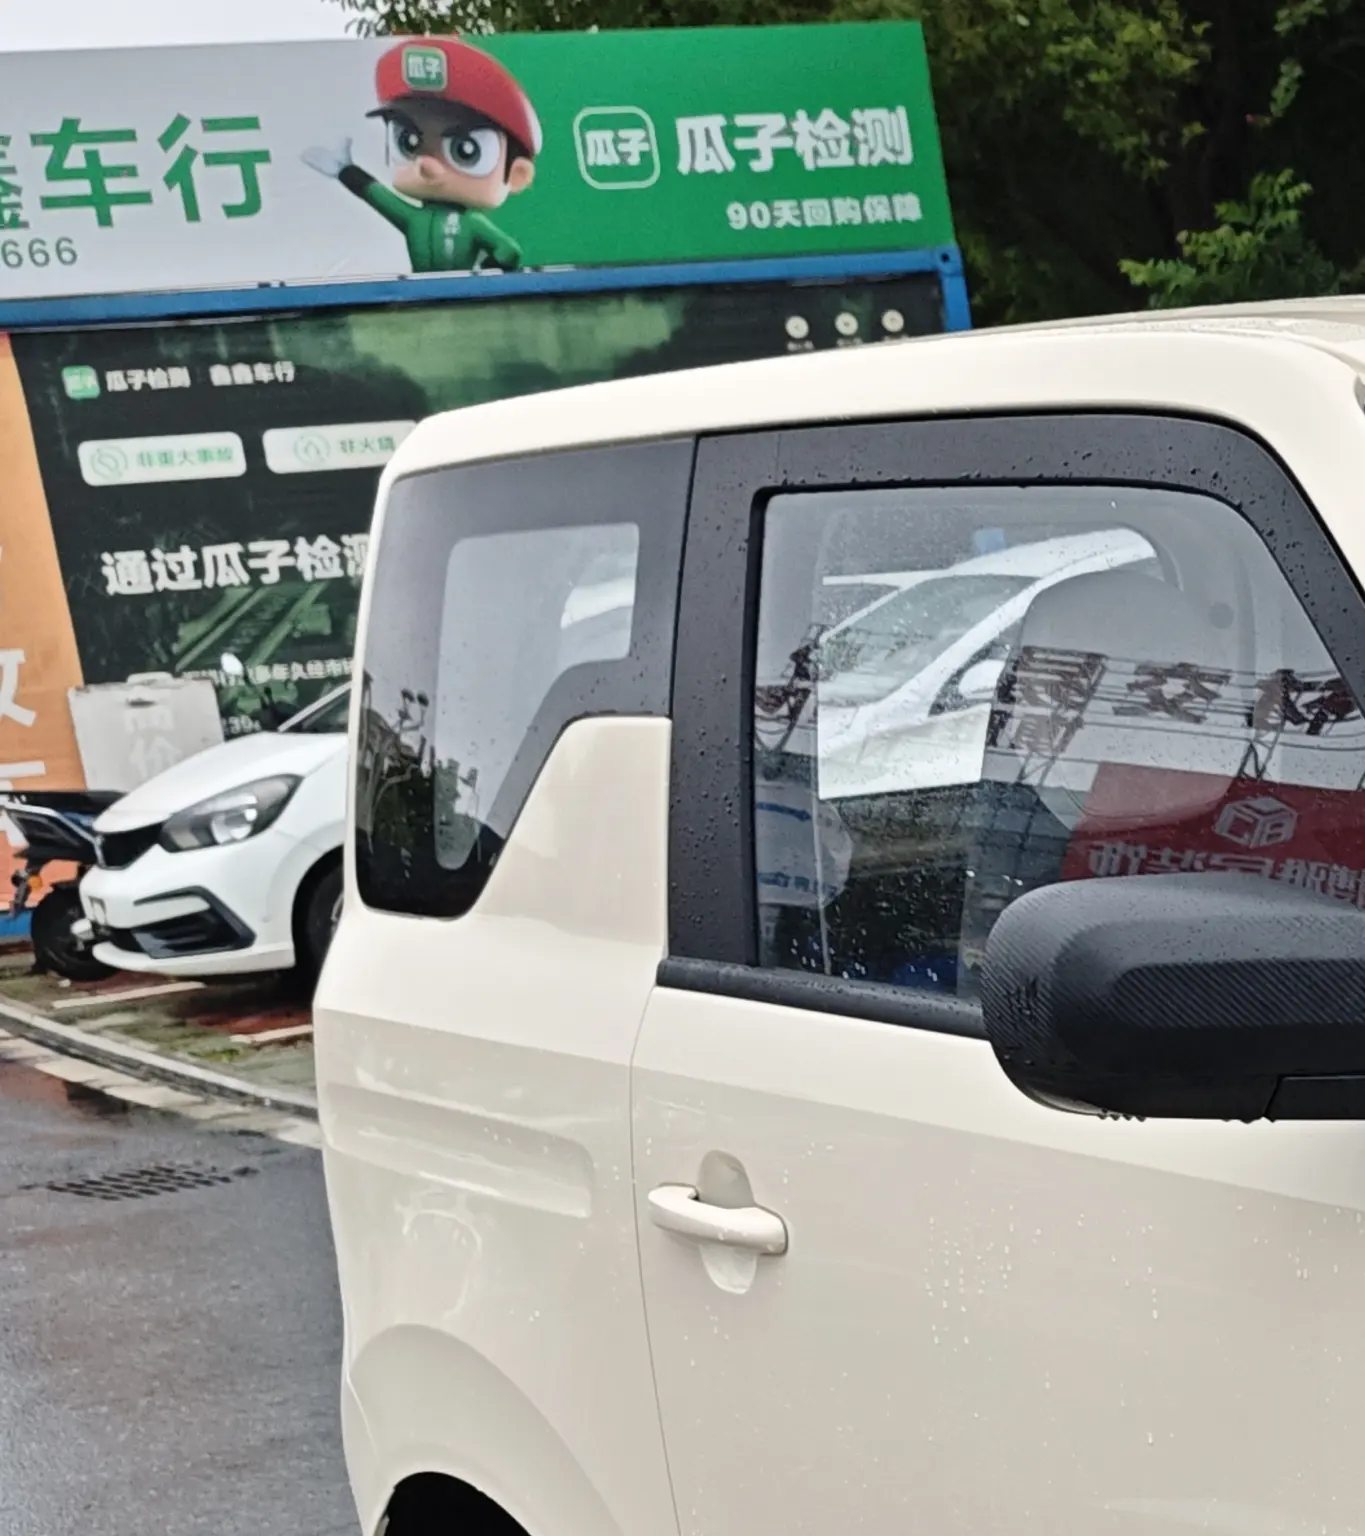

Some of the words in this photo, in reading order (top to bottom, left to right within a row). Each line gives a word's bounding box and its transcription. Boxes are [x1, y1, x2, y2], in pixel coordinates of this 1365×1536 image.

[0, 112, 272, 230] 车行
[584, 128, 651, 167] 瓜子
[675, 105, 914, 176] 瓜子检测
[725, 192, 923, 231] 90天回购保障
